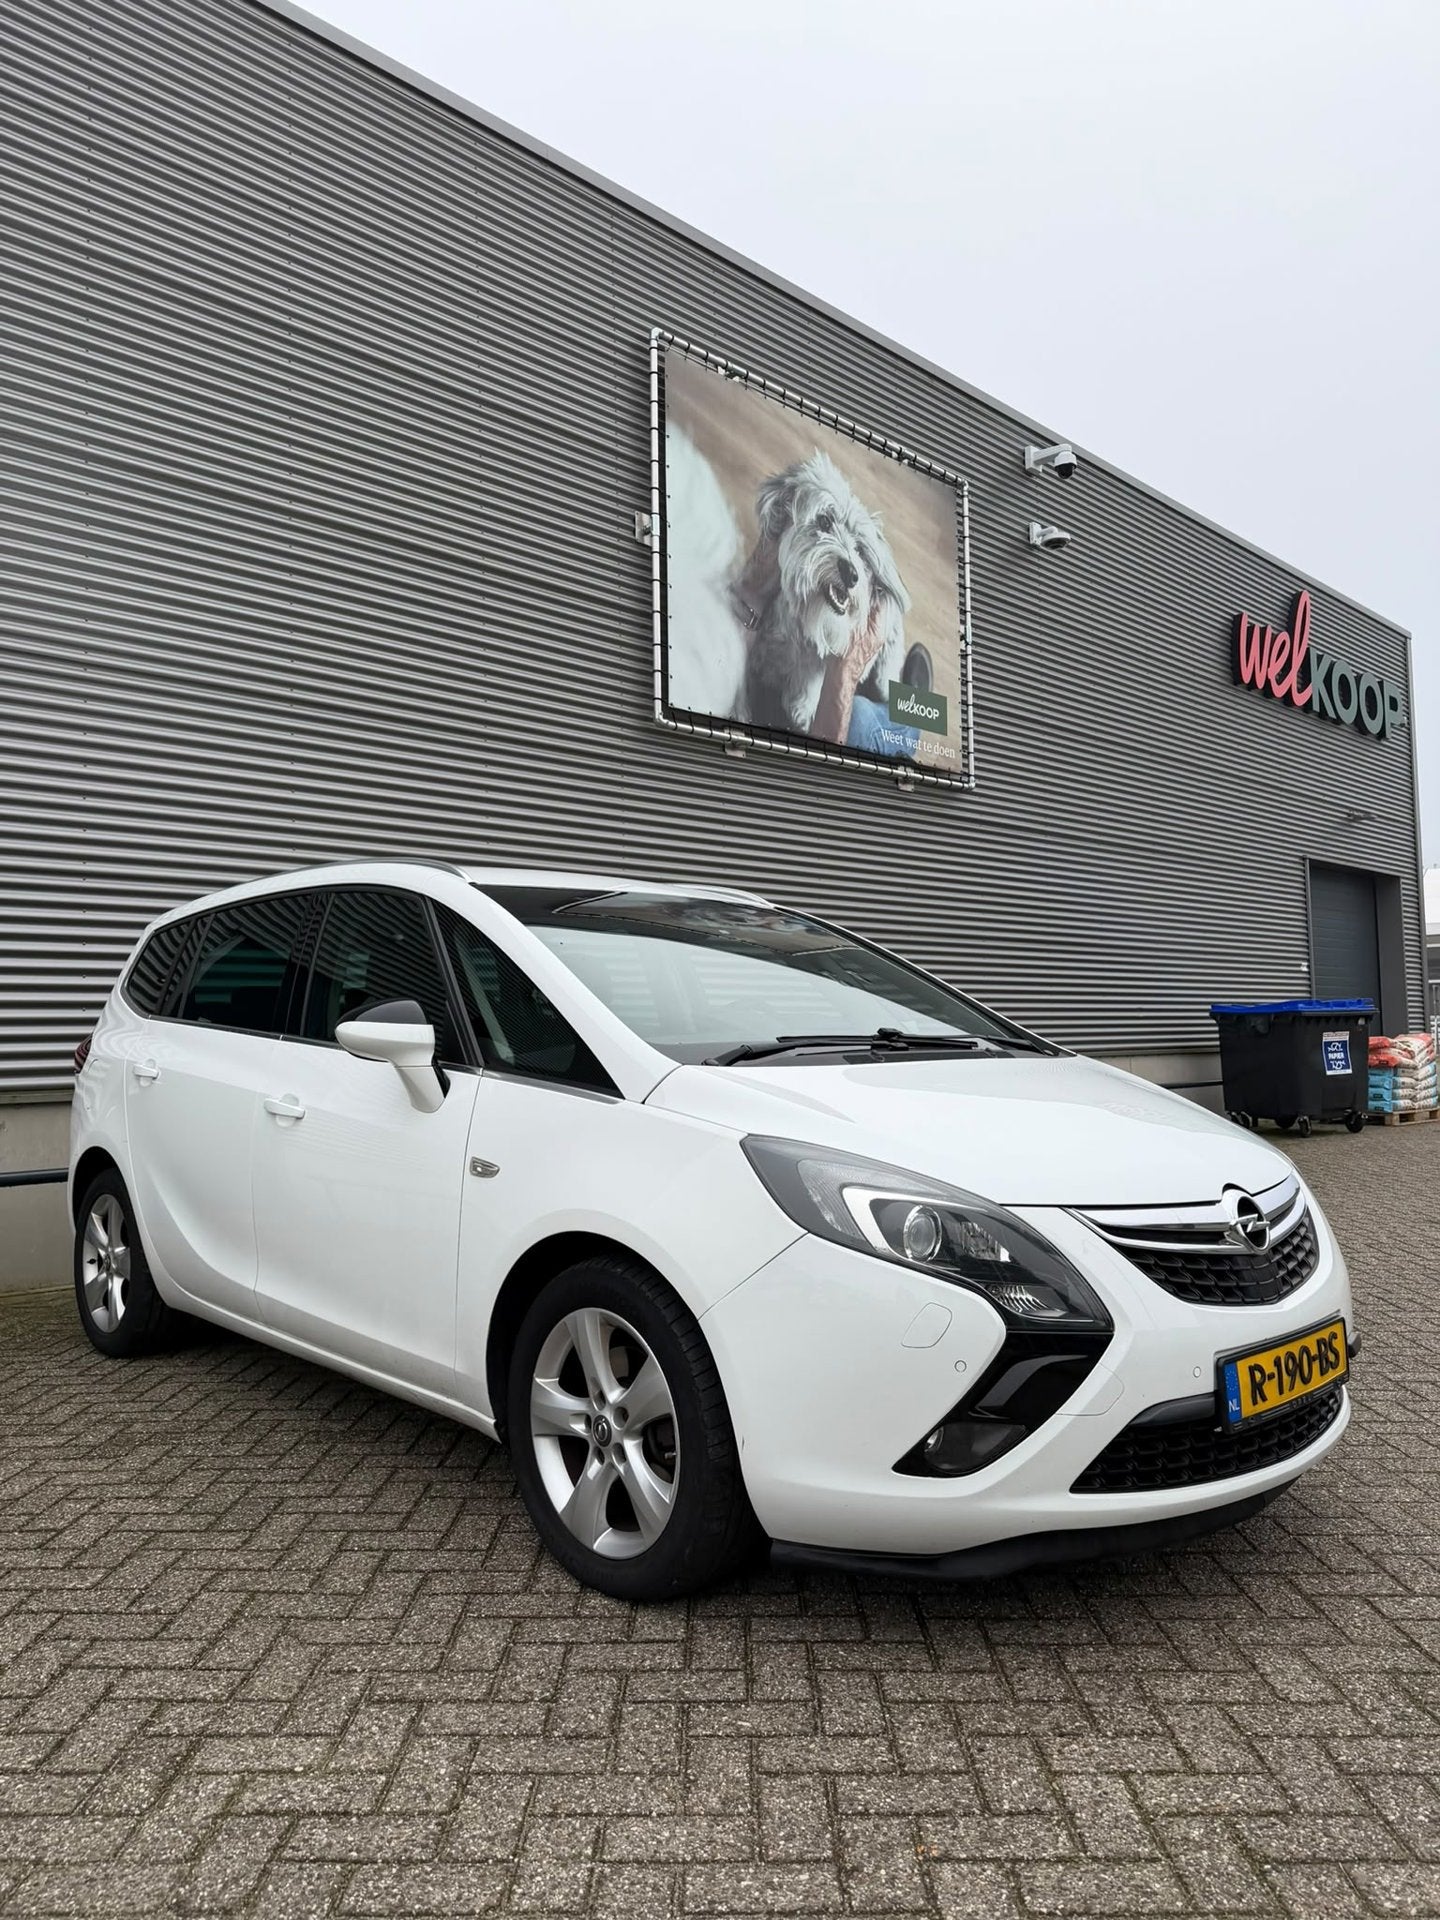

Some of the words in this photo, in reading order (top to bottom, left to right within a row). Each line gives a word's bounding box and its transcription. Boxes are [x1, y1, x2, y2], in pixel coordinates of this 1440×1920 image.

[880, 728, 904, 746] Weet
[905, 737, 921, 750] wat
[923, 741, 932, 752] te
[934, 742, 955, 758] doen
[1248, 1331, 1340, 1406] R-190-BS
[1228, 1399, 1240, 1412] NL
